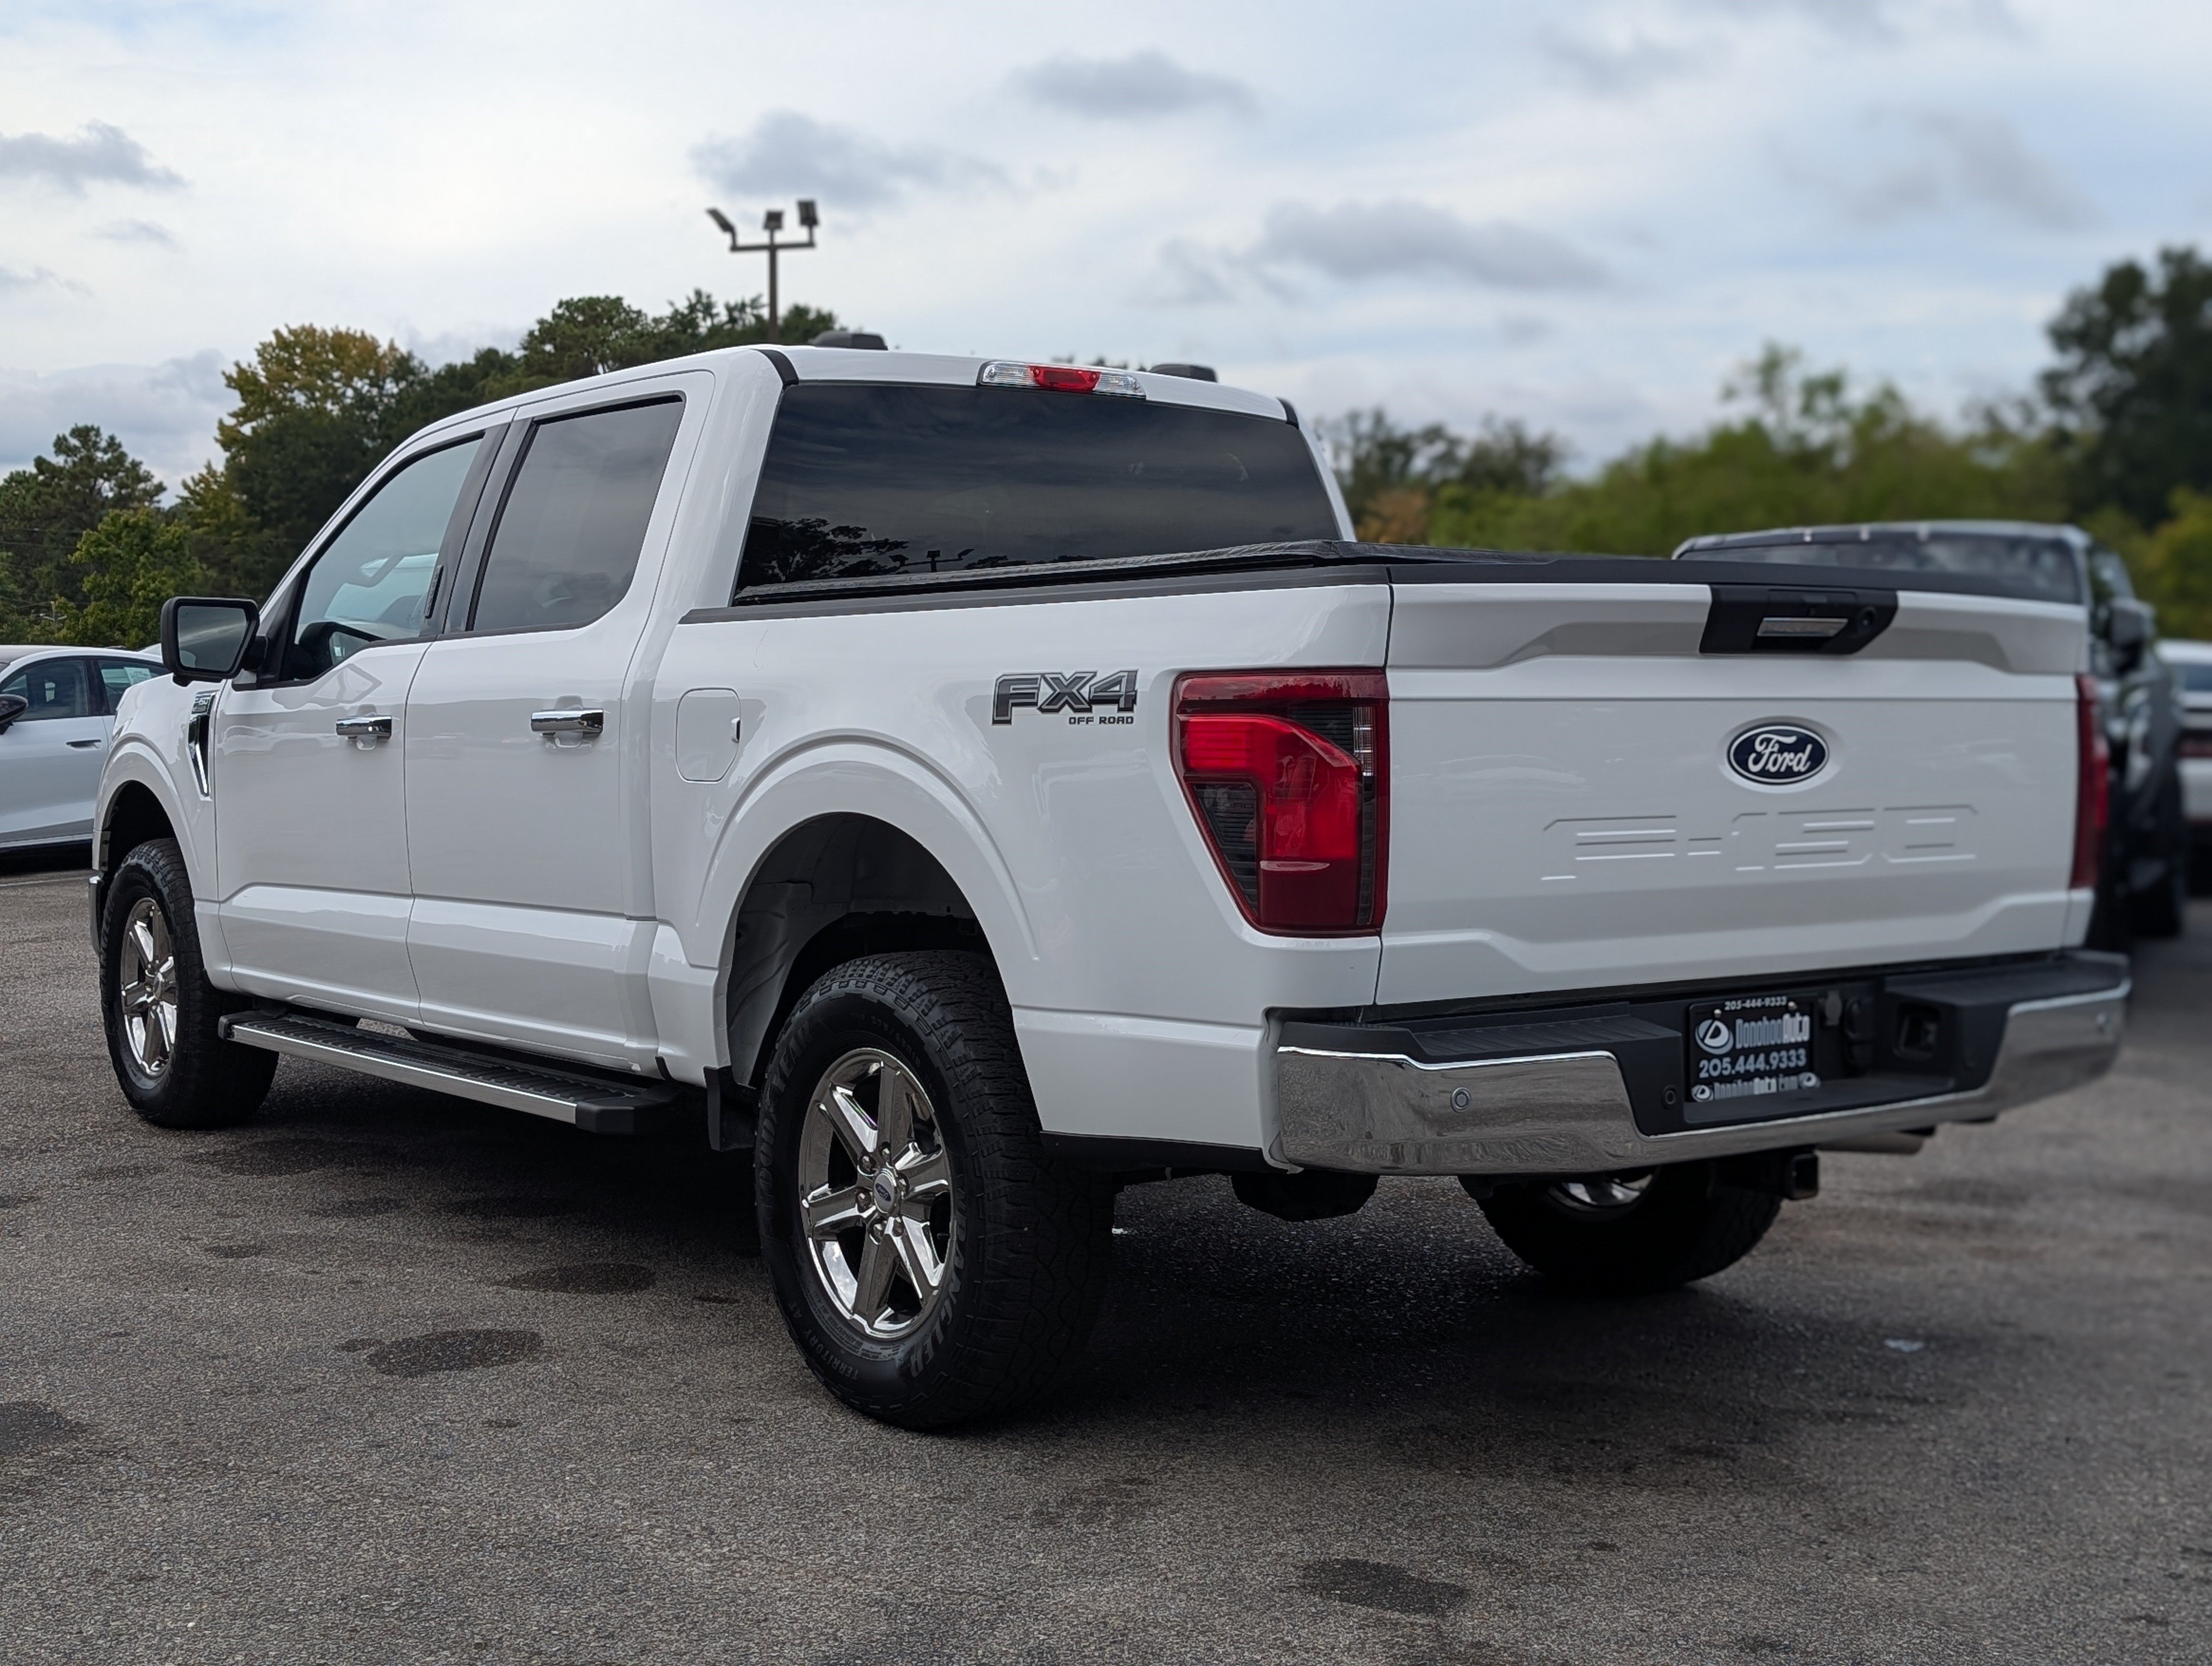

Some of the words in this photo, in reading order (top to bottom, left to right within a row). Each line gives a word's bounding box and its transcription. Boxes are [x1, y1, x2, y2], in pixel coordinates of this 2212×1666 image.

[992, 669, 1139, 726] FX4
[1068, 716, 1094, 725] OFF
[1099, 716, 1134, 725] ROAD
[1747, 733, 1812, 773] Ford
[1724, 996, 1787, 1011] 205-444-9333
[1699, 1048, 1806, 1078] 205.444.9333
[788, 1302, 802, 1319] AT
[803, 1329, 859, 1381] TERRITORY
